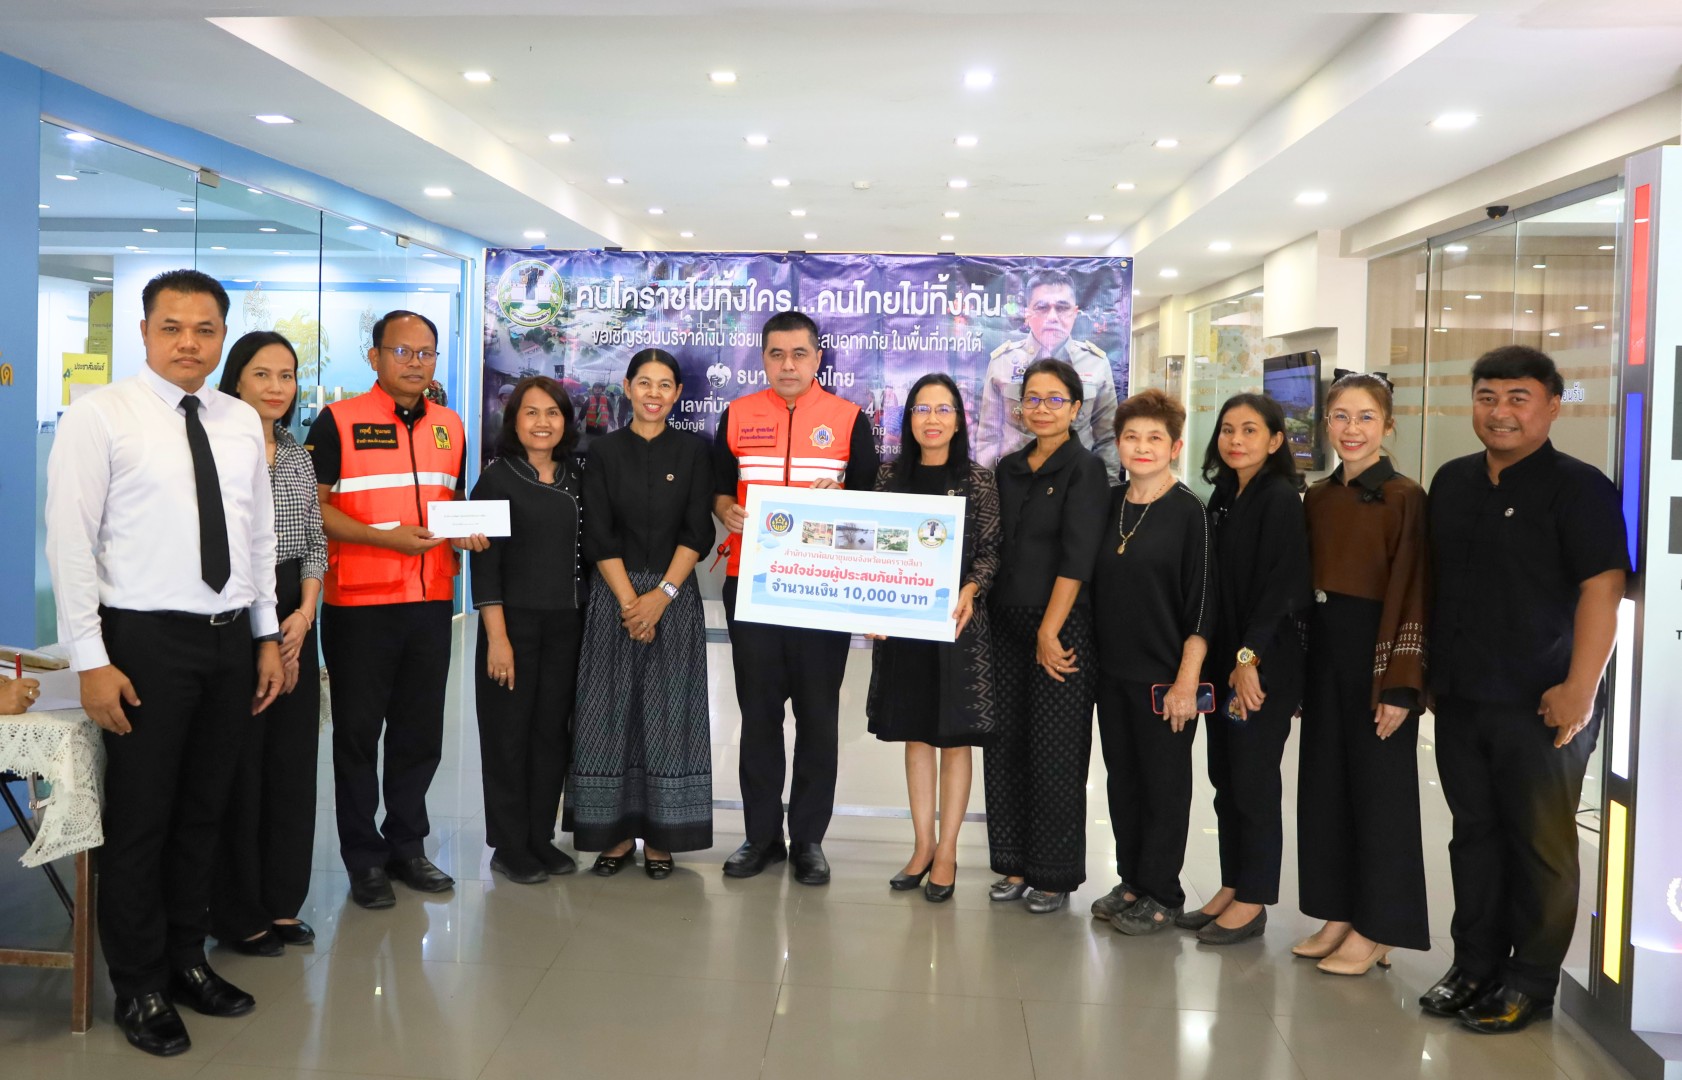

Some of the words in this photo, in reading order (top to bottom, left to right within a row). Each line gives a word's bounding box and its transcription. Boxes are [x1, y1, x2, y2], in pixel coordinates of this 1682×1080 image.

[892, 325, 982, 352] ในพื้นที่ภาคใต้
[737, 369, 769, 385] ธนา
[815, 365, 855, 387] งไทย
[1562, 381, 1585, 402] อนรับ
[770, 561, 935, 587] ร่วมใจช่วยผู้ประสบภัยน้ำท่วม
[771, 578, 838, 597] จำนวนเงิน
[843, 586, 897, 603] 10,000
[900, 593, 928, 605] บาท
